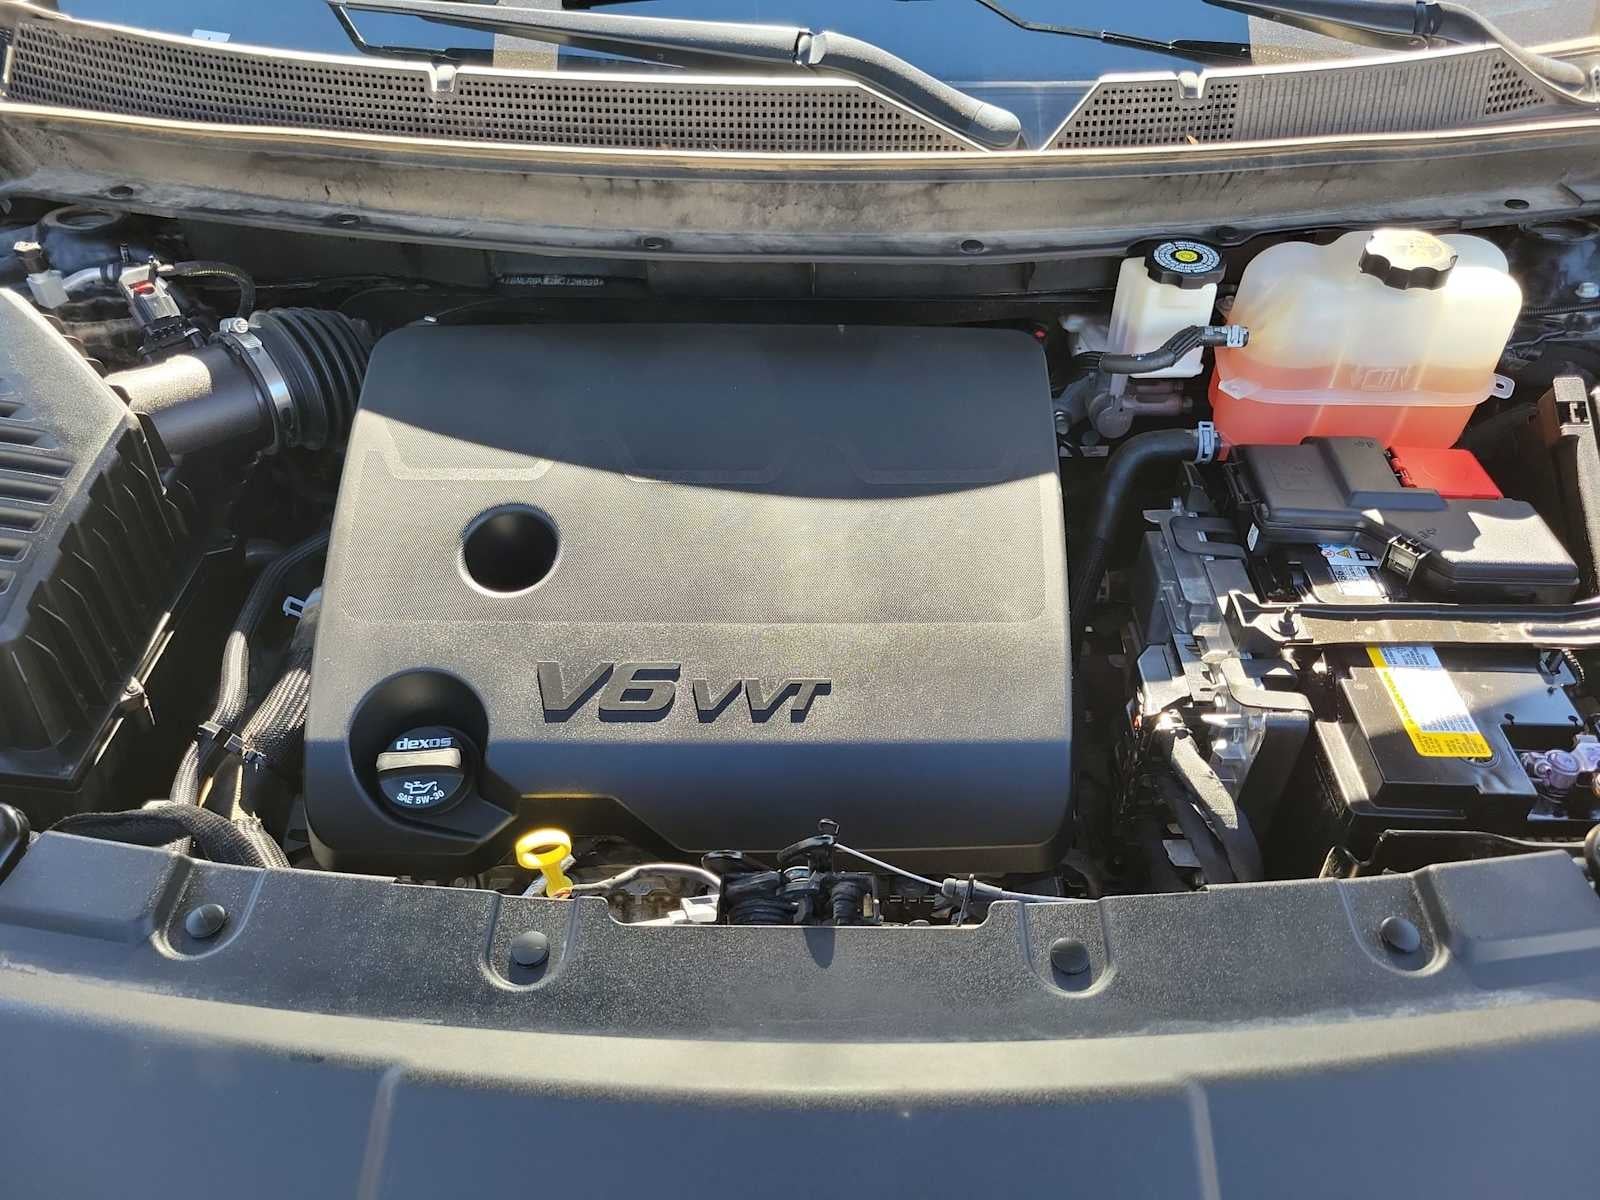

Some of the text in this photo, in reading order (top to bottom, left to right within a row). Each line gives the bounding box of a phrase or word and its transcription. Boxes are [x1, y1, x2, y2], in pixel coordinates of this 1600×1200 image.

[536, 660, 832, 723] V6 VVT
[396, 737, 453, 750] dexos
[396, 790, 445, 805] SAE 5W-30
